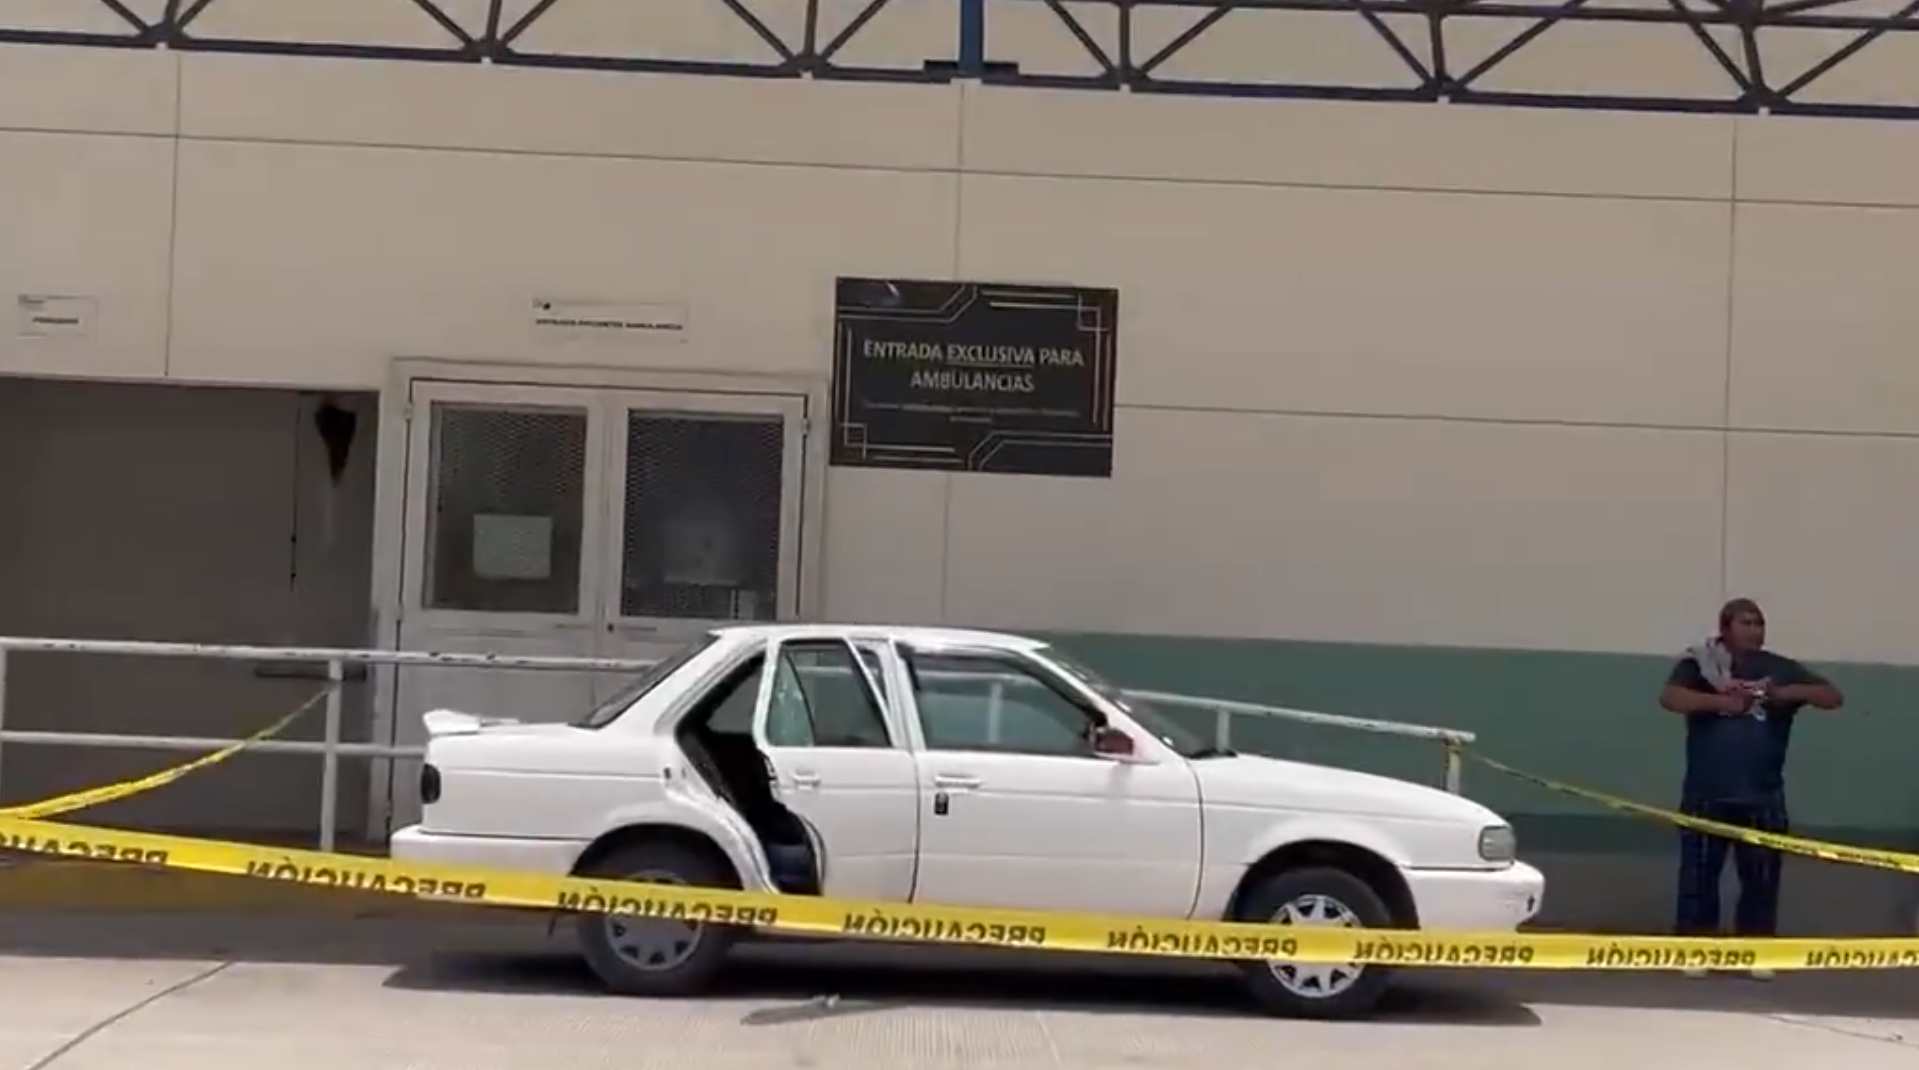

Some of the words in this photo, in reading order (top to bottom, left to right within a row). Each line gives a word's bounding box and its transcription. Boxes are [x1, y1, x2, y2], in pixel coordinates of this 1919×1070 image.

[863, 339, 942, 360] ENTRADA
[946, 344, 1035, 365] EXCLUSIVA
[1039, 348, 1084, 366] PARA
[910, 370, 1035, 393] AMBULANCIAS
